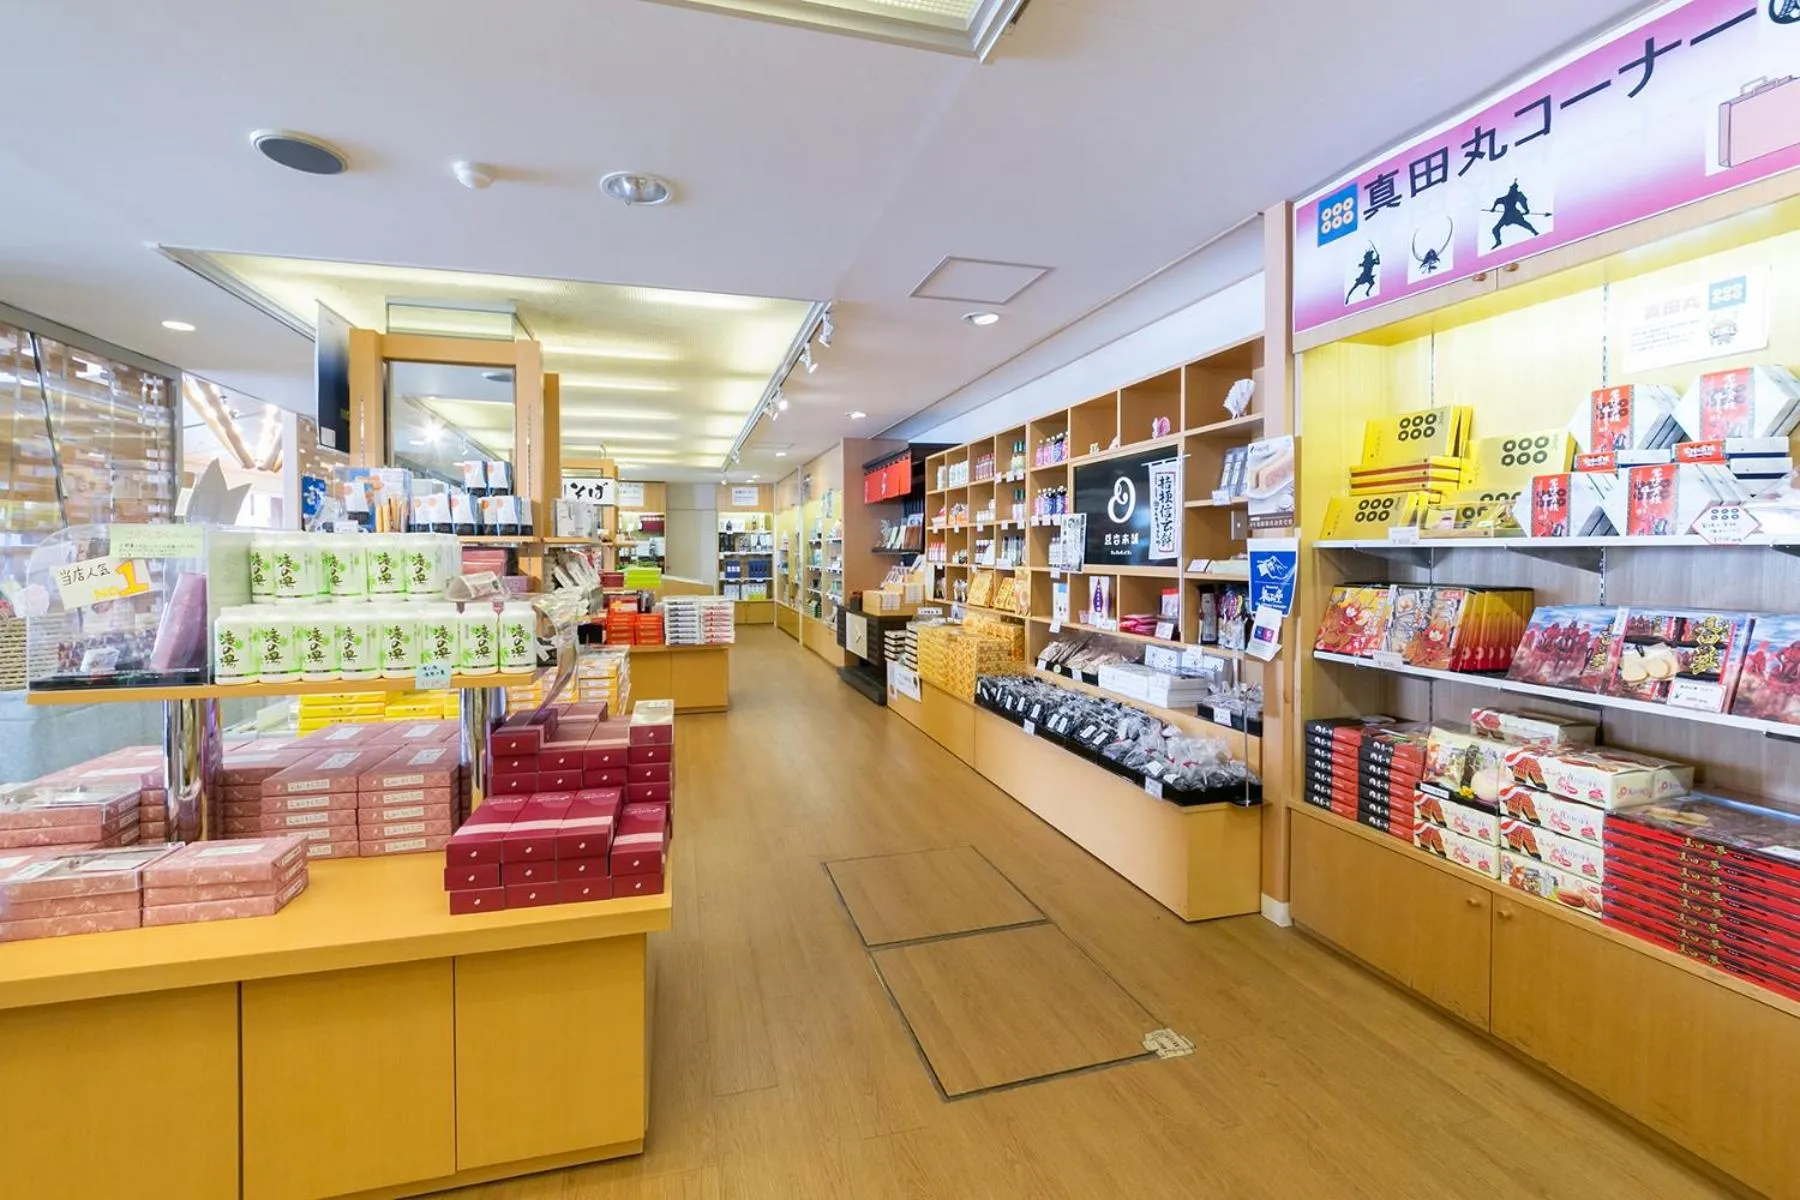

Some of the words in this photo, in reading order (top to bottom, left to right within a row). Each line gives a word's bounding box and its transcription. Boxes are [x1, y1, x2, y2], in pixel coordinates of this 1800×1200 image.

[1362, 7, 1758, 221] 真田丸コーナー
[564, 481, 609, 500] そば
[59, 562, 111, 587] 当店人気
